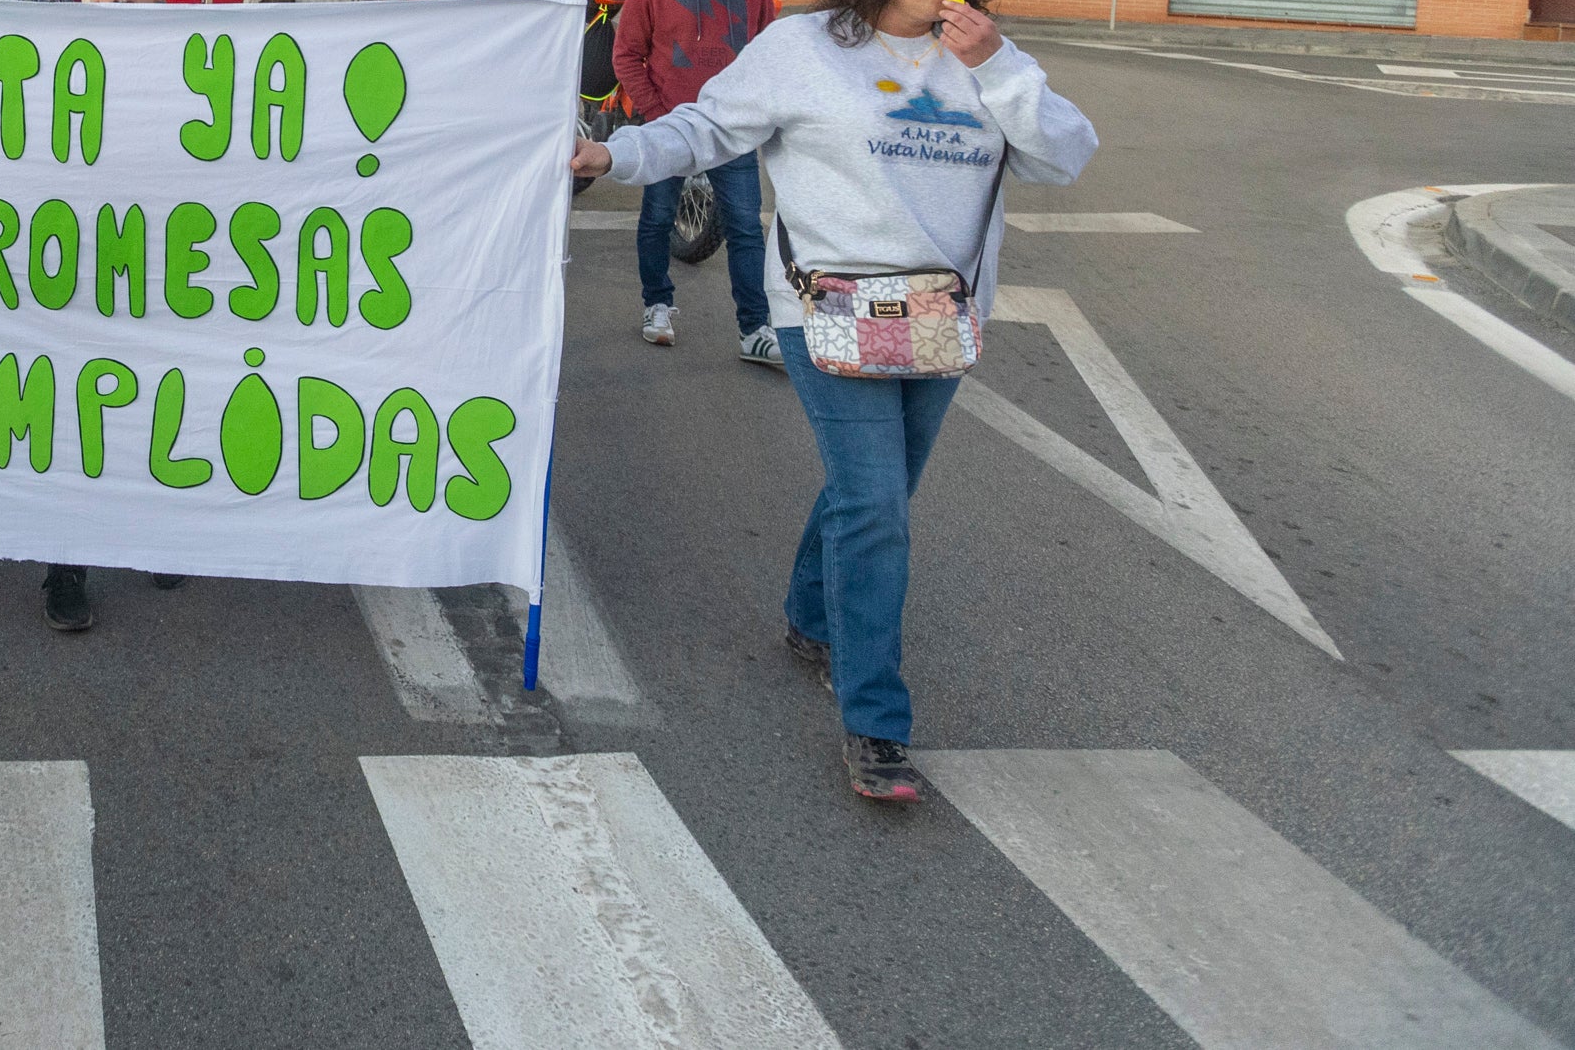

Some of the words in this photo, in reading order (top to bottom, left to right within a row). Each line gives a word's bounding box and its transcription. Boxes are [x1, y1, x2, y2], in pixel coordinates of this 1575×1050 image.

[901, 126, 966, 146] A.M.P.A.
[867, 139, 919, 158] Vista
[921, 145, 993, 167] Nevada
